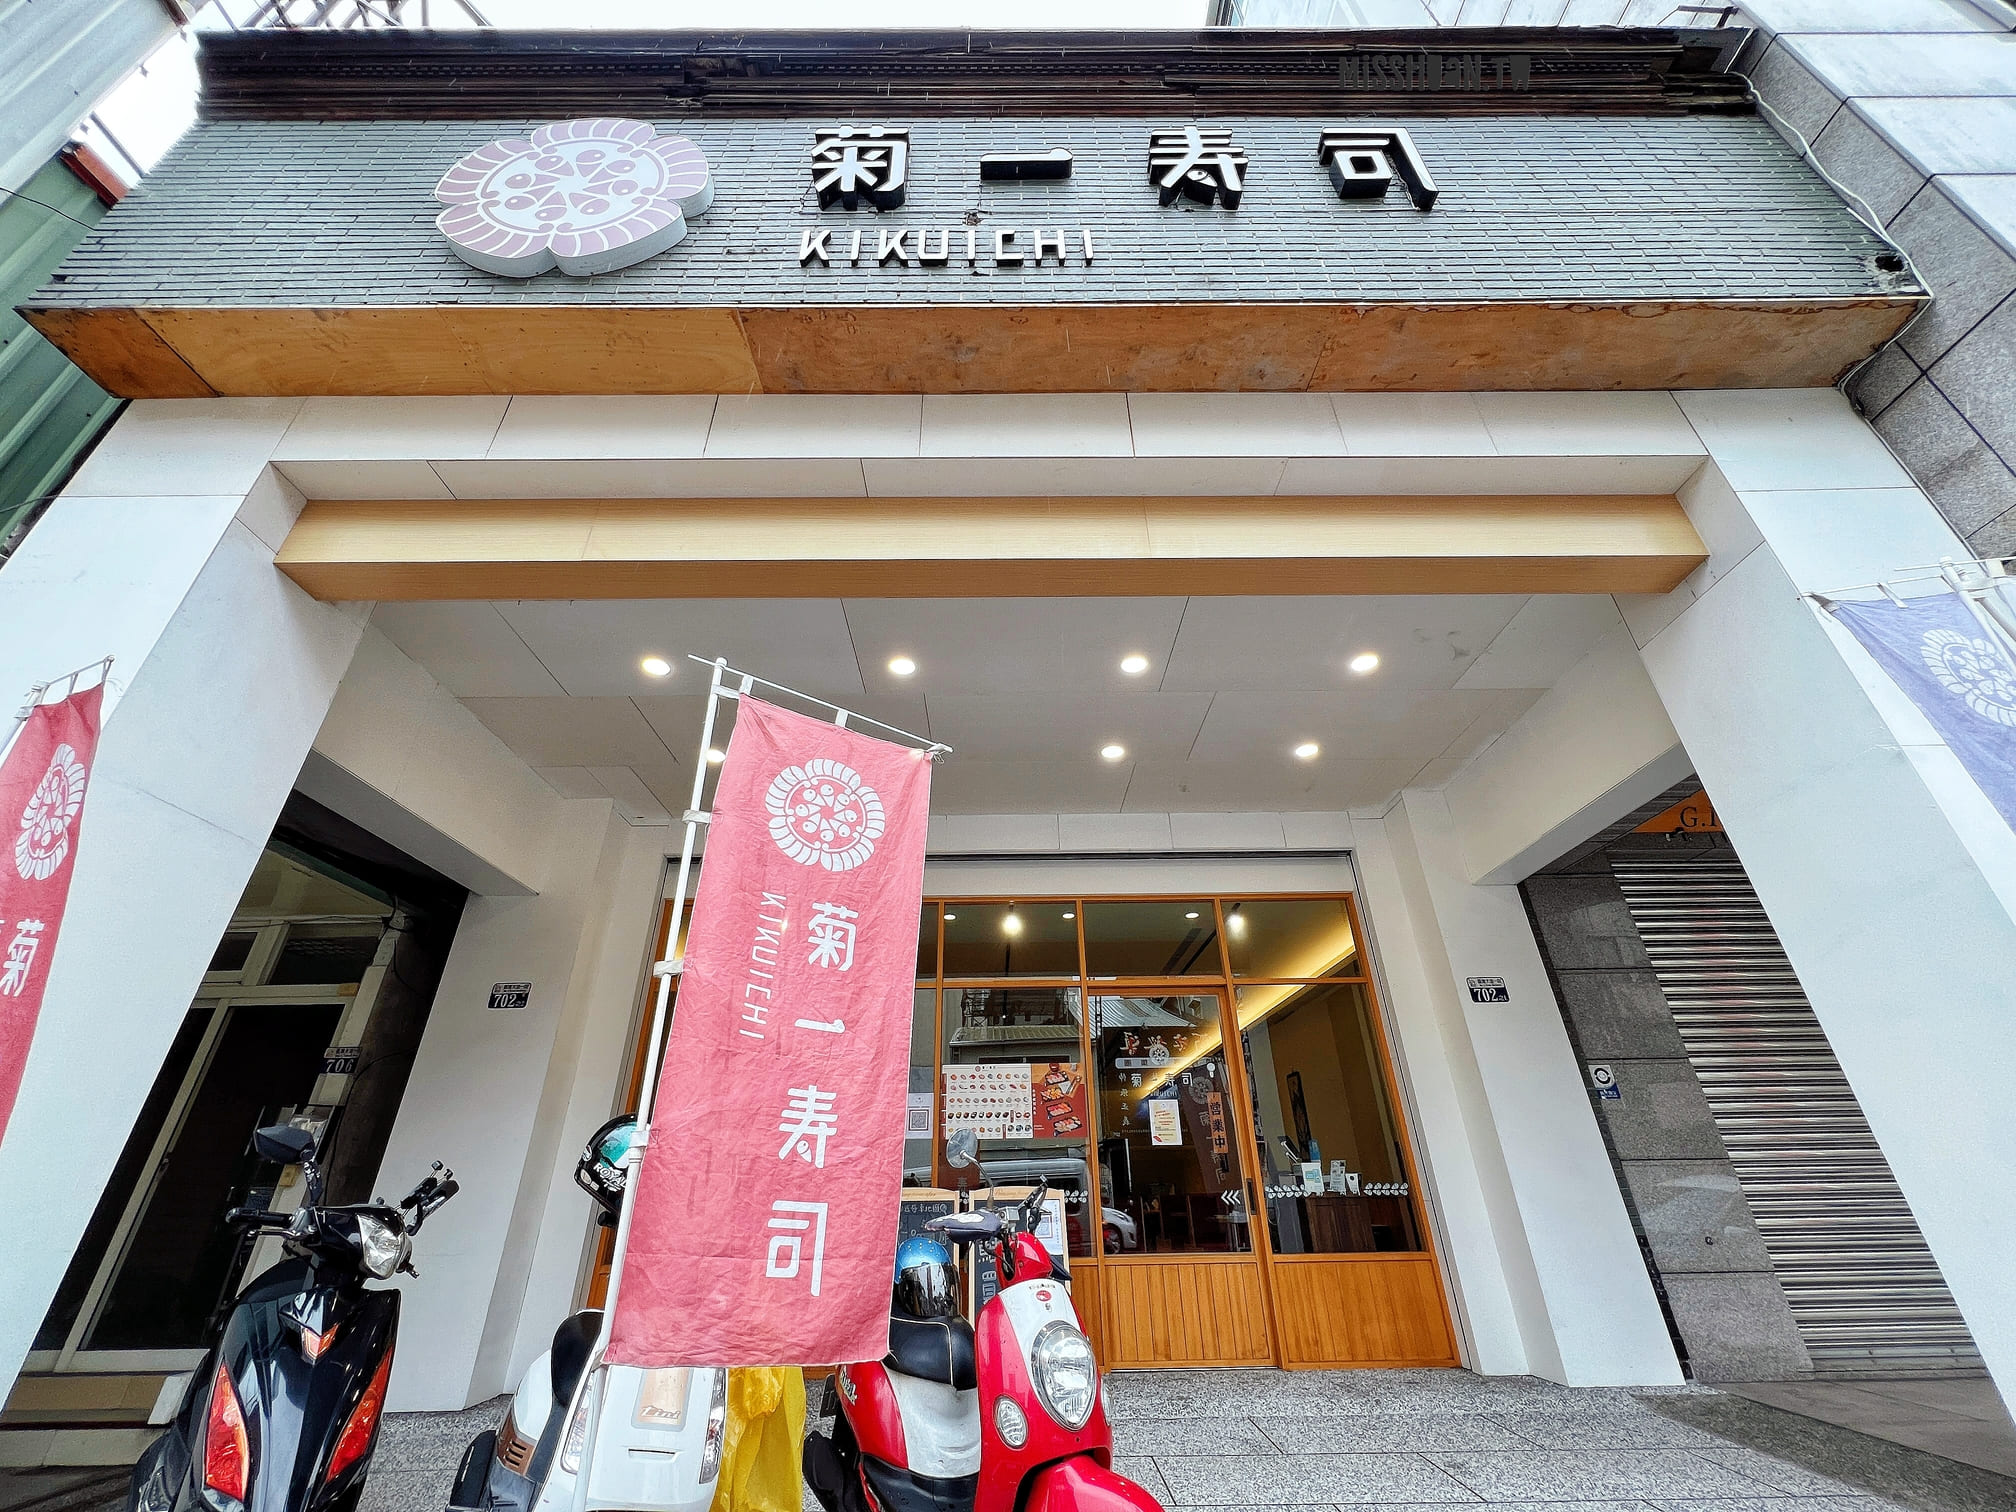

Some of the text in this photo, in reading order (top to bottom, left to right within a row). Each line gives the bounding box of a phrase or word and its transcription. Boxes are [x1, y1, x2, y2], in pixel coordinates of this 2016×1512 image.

[811, 124, 1439, 210] 菊一寿司
[799, 227, 1095, 268] KIKUICHI
[738, 891, 788, 1042] KIKUICHI
[765, 900, 860, 1297] 菊一寿司
